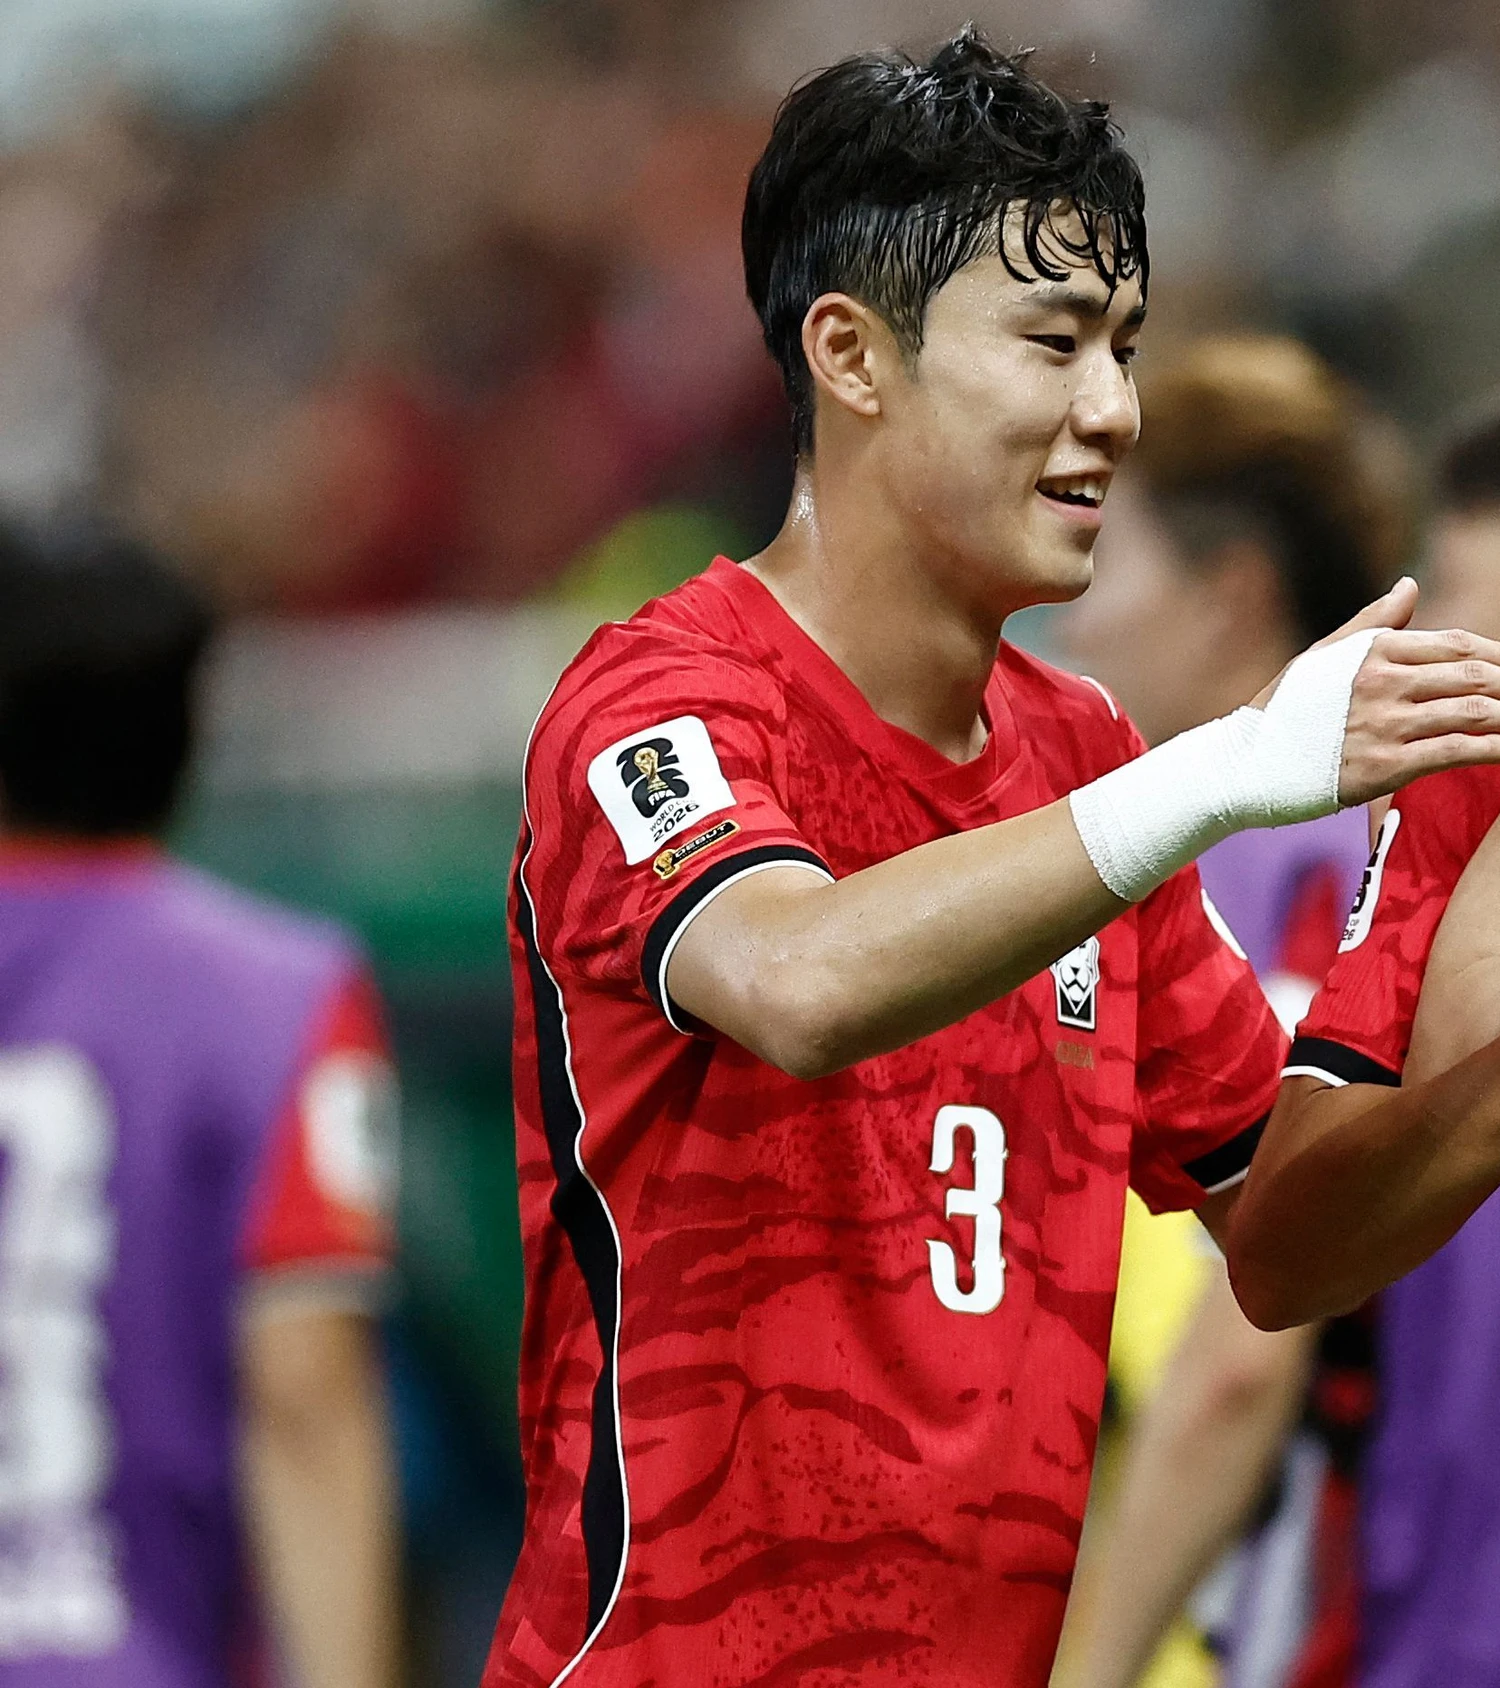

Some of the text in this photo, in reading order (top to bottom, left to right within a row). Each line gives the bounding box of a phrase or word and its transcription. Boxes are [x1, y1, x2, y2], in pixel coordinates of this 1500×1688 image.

[648, 789, 677, 806] FIFA
[649, 804, 675, 831] WORLD
[653, 803, 700, 842] 2026
[926, 1104, 1009, 1315] 3
